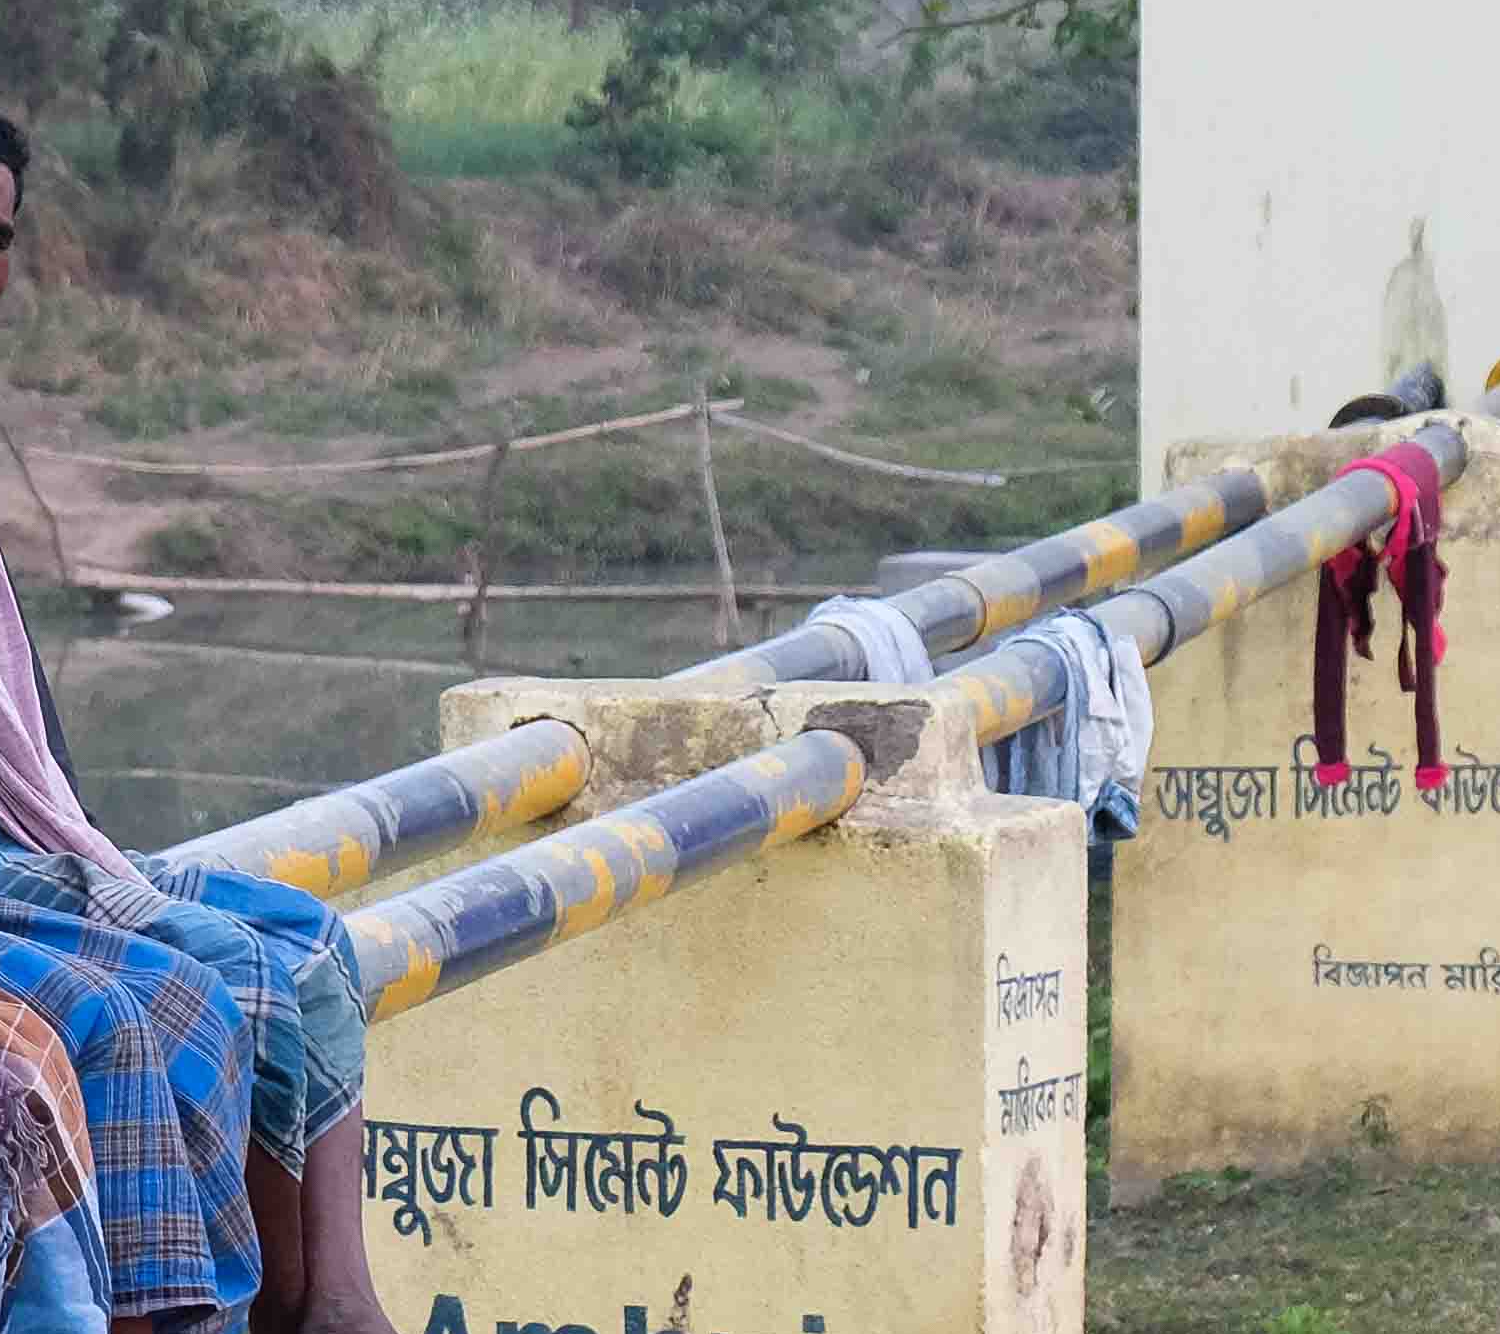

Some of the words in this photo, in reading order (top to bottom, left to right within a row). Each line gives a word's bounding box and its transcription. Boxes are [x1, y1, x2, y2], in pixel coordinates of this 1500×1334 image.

[1153, 765, 1280, 843] অম্বুজা
[362, 1118, 500, 1247] ম্বুজা
[517, 1087, 688, 1217] সিমেন্ট
[713, 1112, 963, 1228] ফাউন্ডেশন
